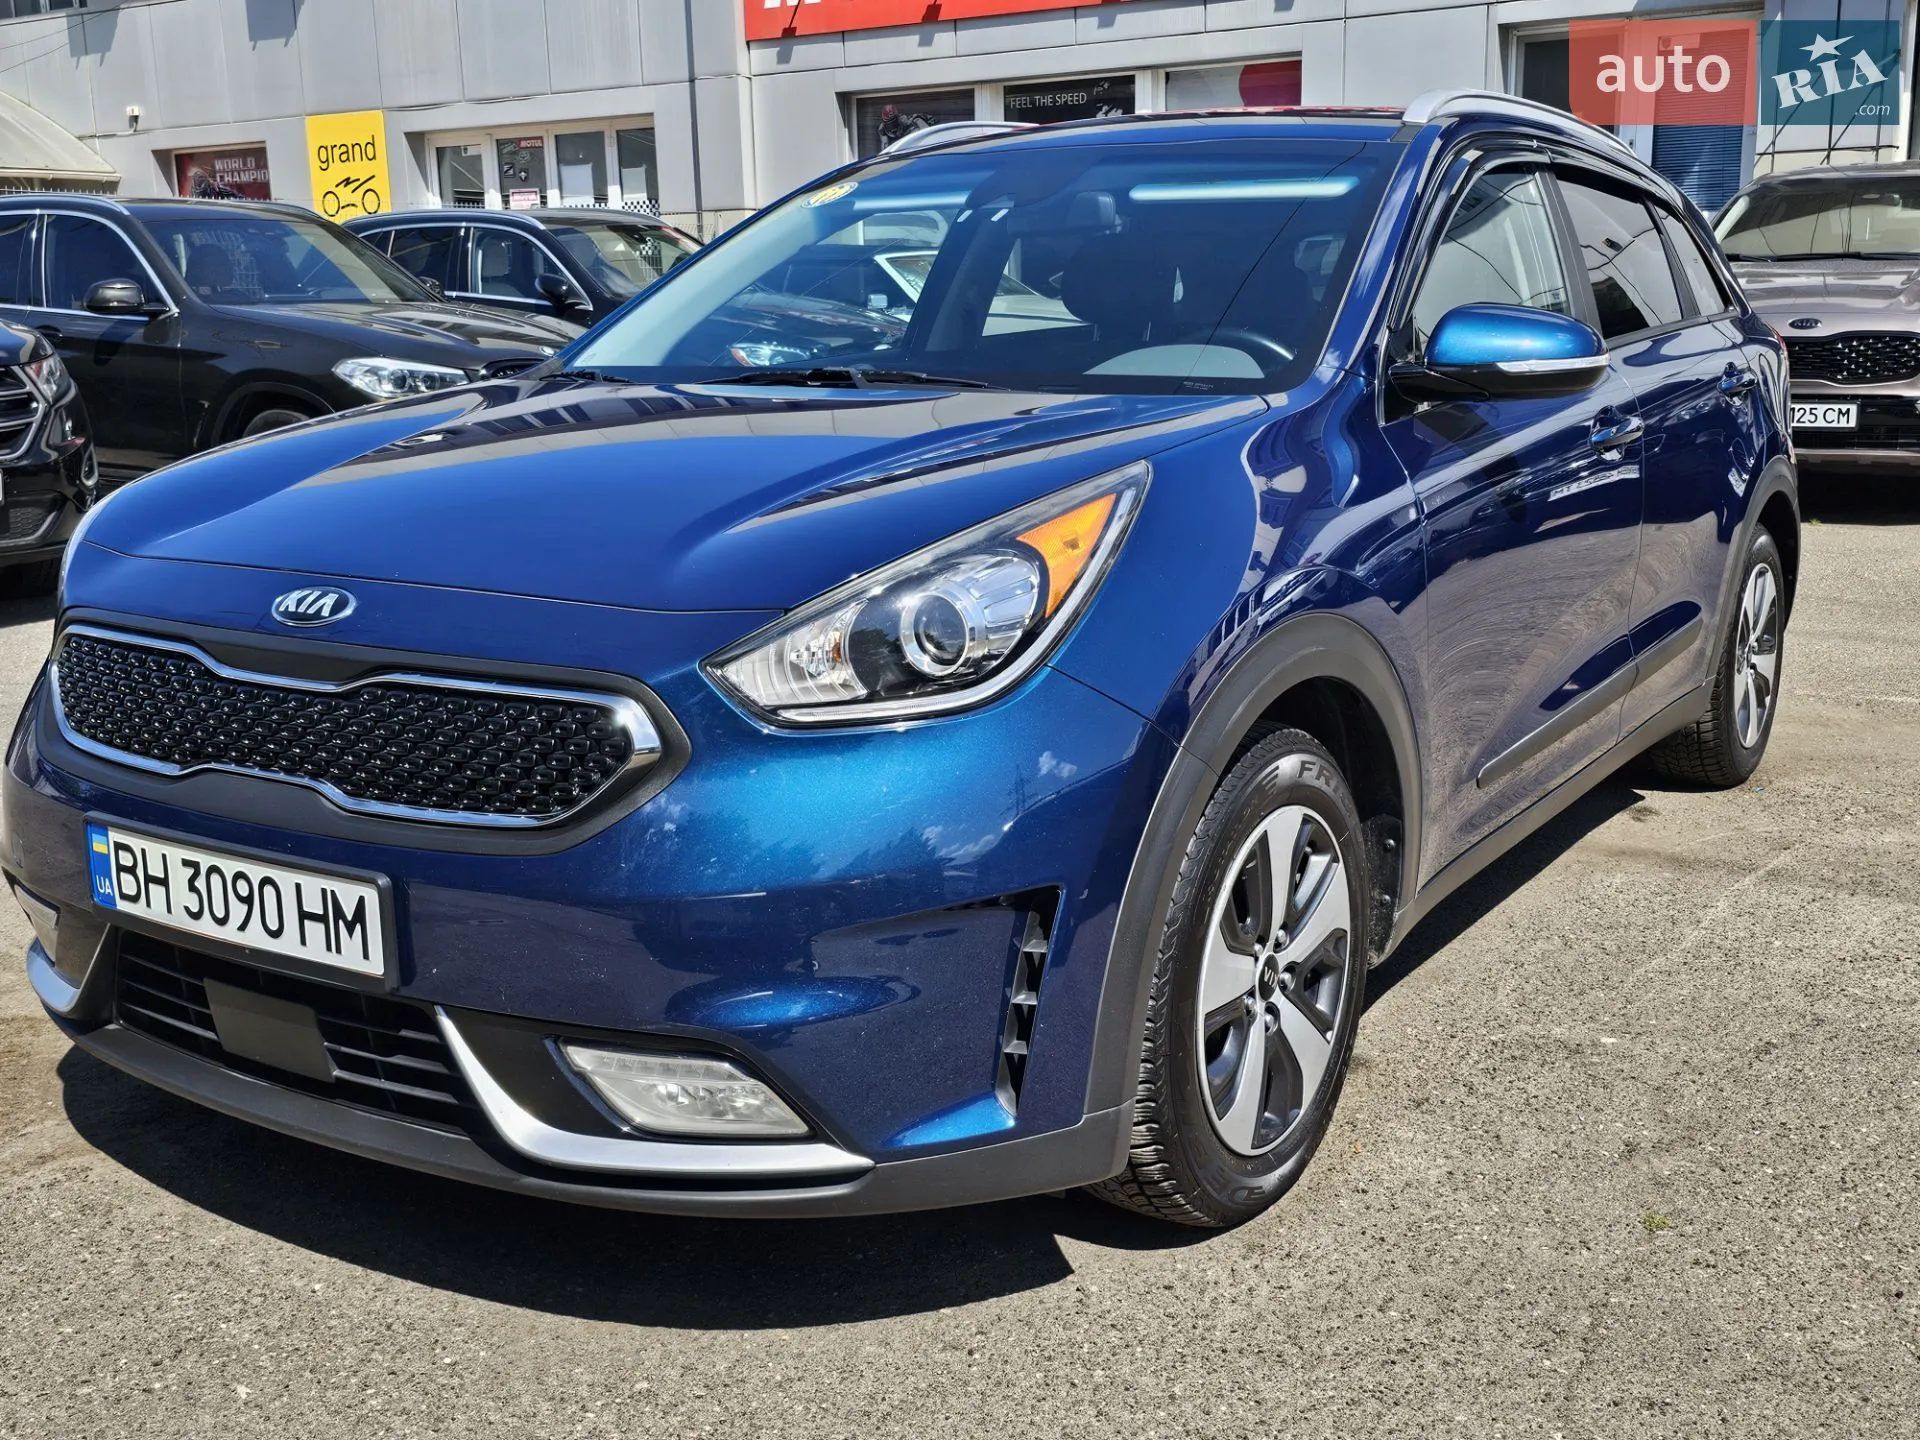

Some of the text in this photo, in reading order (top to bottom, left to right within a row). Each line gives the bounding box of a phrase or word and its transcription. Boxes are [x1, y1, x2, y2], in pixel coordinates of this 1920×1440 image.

[1010, 92, 1087, 109] FEEL THE SPEED
[317, 134, 377, 171] grand
[519, 138, 543, 149] MOTUL
[214, 156, 256, 171] WORLD
[1823, 407, 1851, 425] CM
[279, 590, 340, 617] KIA
[96, 875, 113, 897] UA
[113, 840, 371, 961] BH 3090 HM
